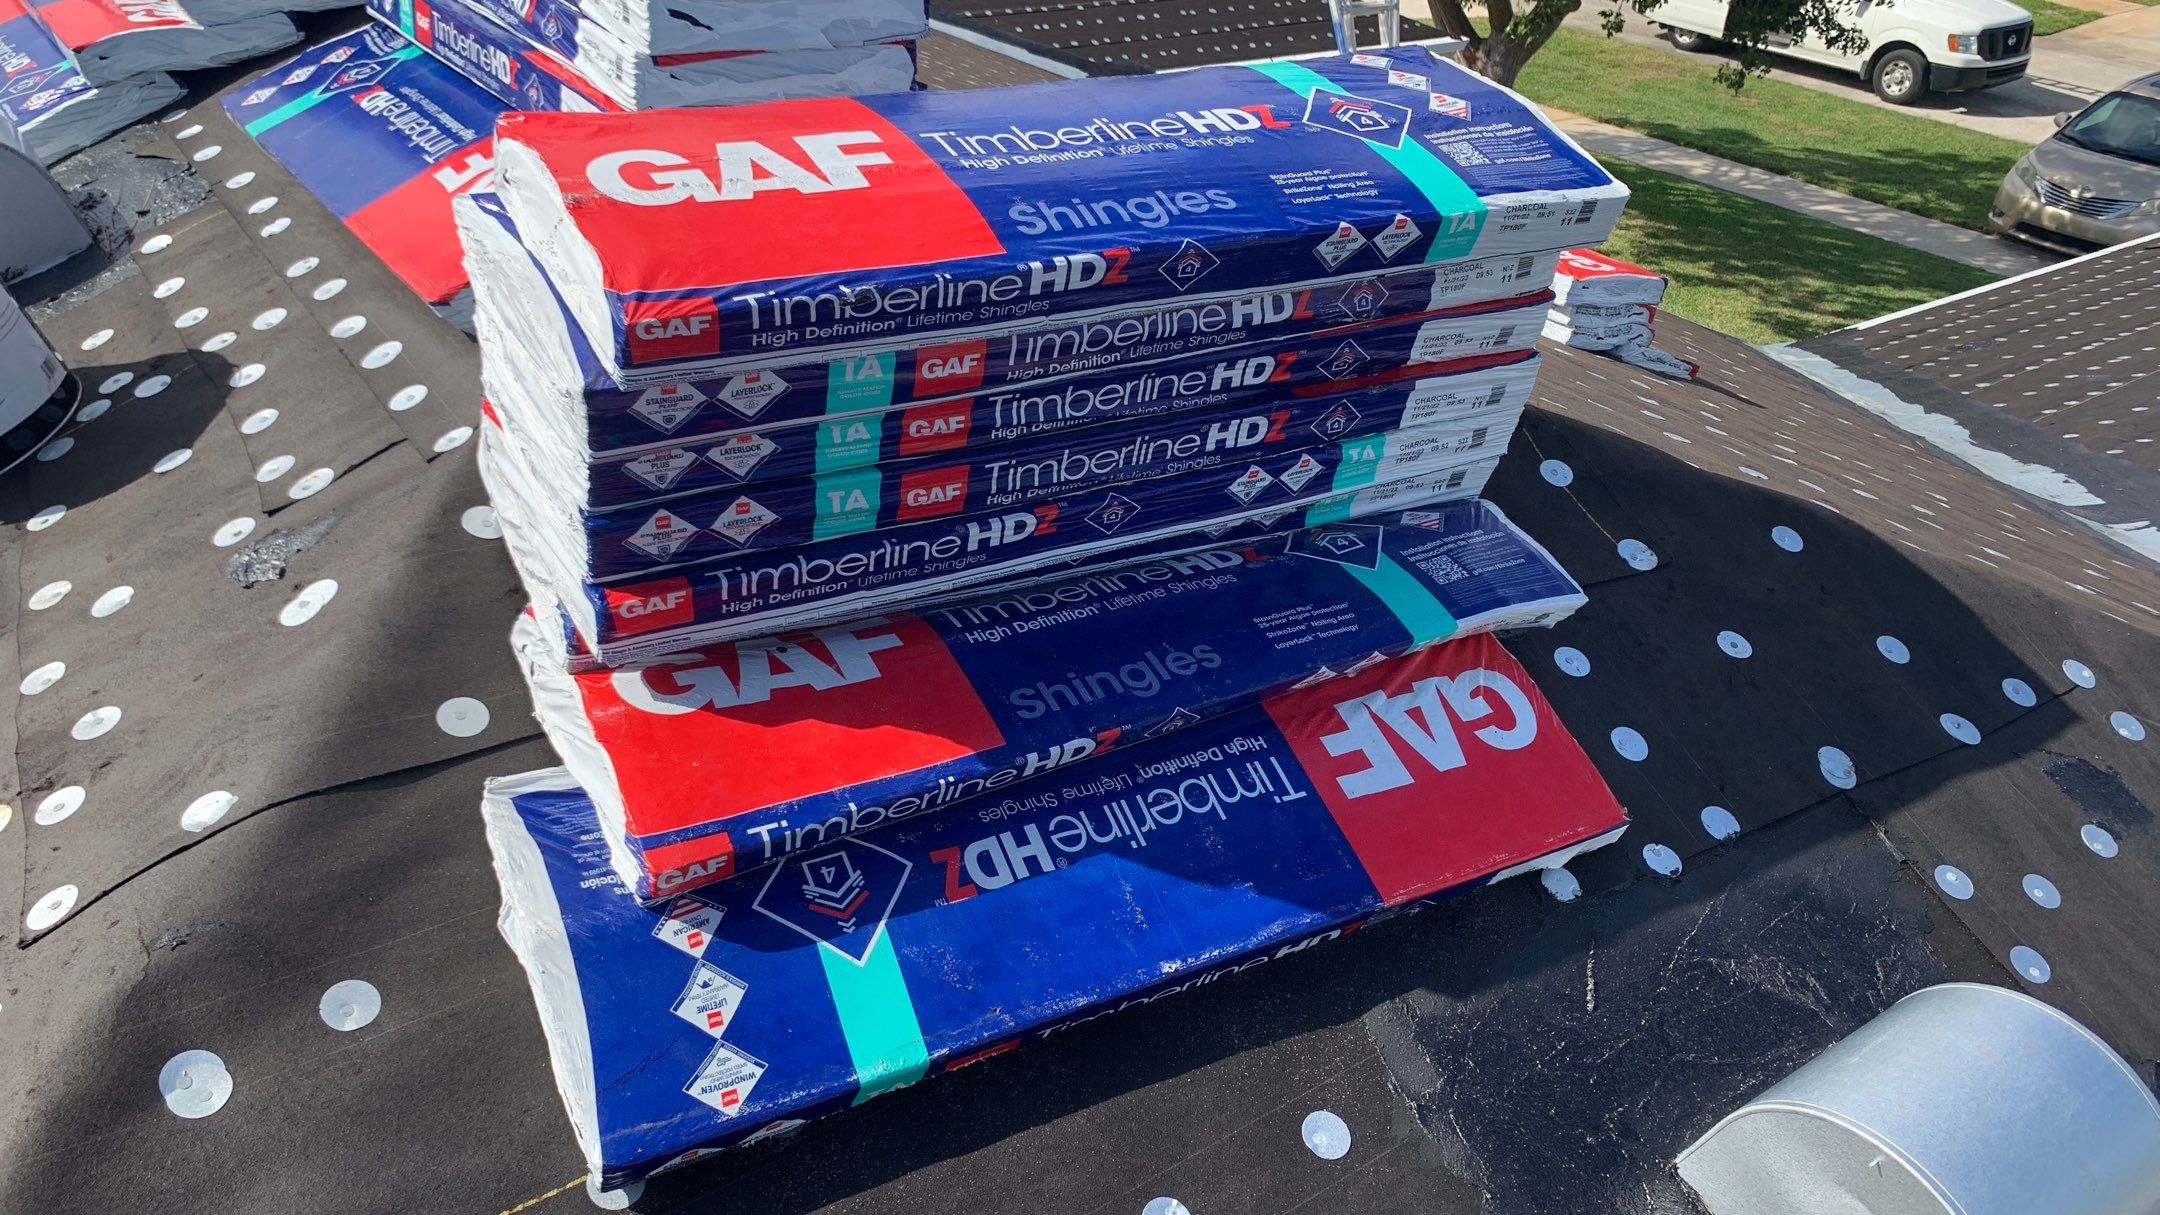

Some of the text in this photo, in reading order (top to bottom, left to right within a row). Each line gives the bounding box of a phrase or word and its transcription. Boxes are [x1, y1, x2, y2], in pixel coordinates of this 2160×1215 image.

[961, 155, 1010, 170] High
[1183, 134, 1254, 150] Shingles
[585, 130, 894, 206] GAF
[1305, 175, 1328, 183] Algae
[1327, 181, 1355, 190] Nailing
[1334, 189, 1379, 200] Technology
[1009, 188, 1237, 235] Shingles
[1506, 203, 1548, 213] CHARCOAL
[1449, 211, 1476, 234] TA
[1500, 223, 1527, 231] TP180F
[1560, 217, 1572, 226] 11
[1443, 263, 1484, 276] CHARCOAL
[1501, 274, 1512, 283] 11
[1440, 283, 1466, 294] TP180F
[635, 315, 712, 340] GAF
[752, 331, 798, 347] High
[980, 297, 1051, 319] Shingles
[1423, 332, 1465, 343] CHARCOAL
[1006, 368, 1044, 381] High
[1188, 330, 1246, 347] Shingles
[921, 353, 982, 379] GAF
[646, 394, 694, 406] STAINGUARD
[1414, 392, 1457, 405] CHARCOAL
[1471, 401, 1483, 409] 11
[831, 422, 871, 443] TA
[909, 415, 966, 437] GAF
[991, 425, 1027, 439] High
[1400, 437, 1439, 452] CHARCOAL
[1349, 445, 1376, 463] TA
[651, 461, 670, 469] PLUS
[987, 491, 1022, 505] High
[1166, 455, 1221, 473] Shingles
[1432, 484, 1442, 492] 11
[827, 489, 869, 513] TA
[906, 483, 962, 507] GAF
[1400, 540, 1443, 556] Installation
[1408, 544, 1457, 562] Instrucciones
[722, 598, 763, 614] High
[923, 553, 987, 574] Shingles
[618, 591, 687, 619] GAF
[965, 623, 1012, 644] High
[1167, 572, 1237, 594] Shingles
[1253, 606, 1298, 624] StainGuard
[1258, 616, 1287, 629] 25-year
[1289, 612, 1311, 623] Algae
[1310, 617, 1337, 628] Nailing
[1337, 612, 1355, 621] Area
[1317, 624, 1359, 638] Technology
[611, 618, 904, 715] GAF
[1009, 645, 1222, 719] Shingles
[1319, 668, 1538, 799] GAF
[1227, 735, 1267, 755] High
[979, 793, 1058, 823] Shingles
[657, 855, 728, 889] GAF
[821, 866, 836, 883] 4
[673, 917, 710, 937] AMERICAN
